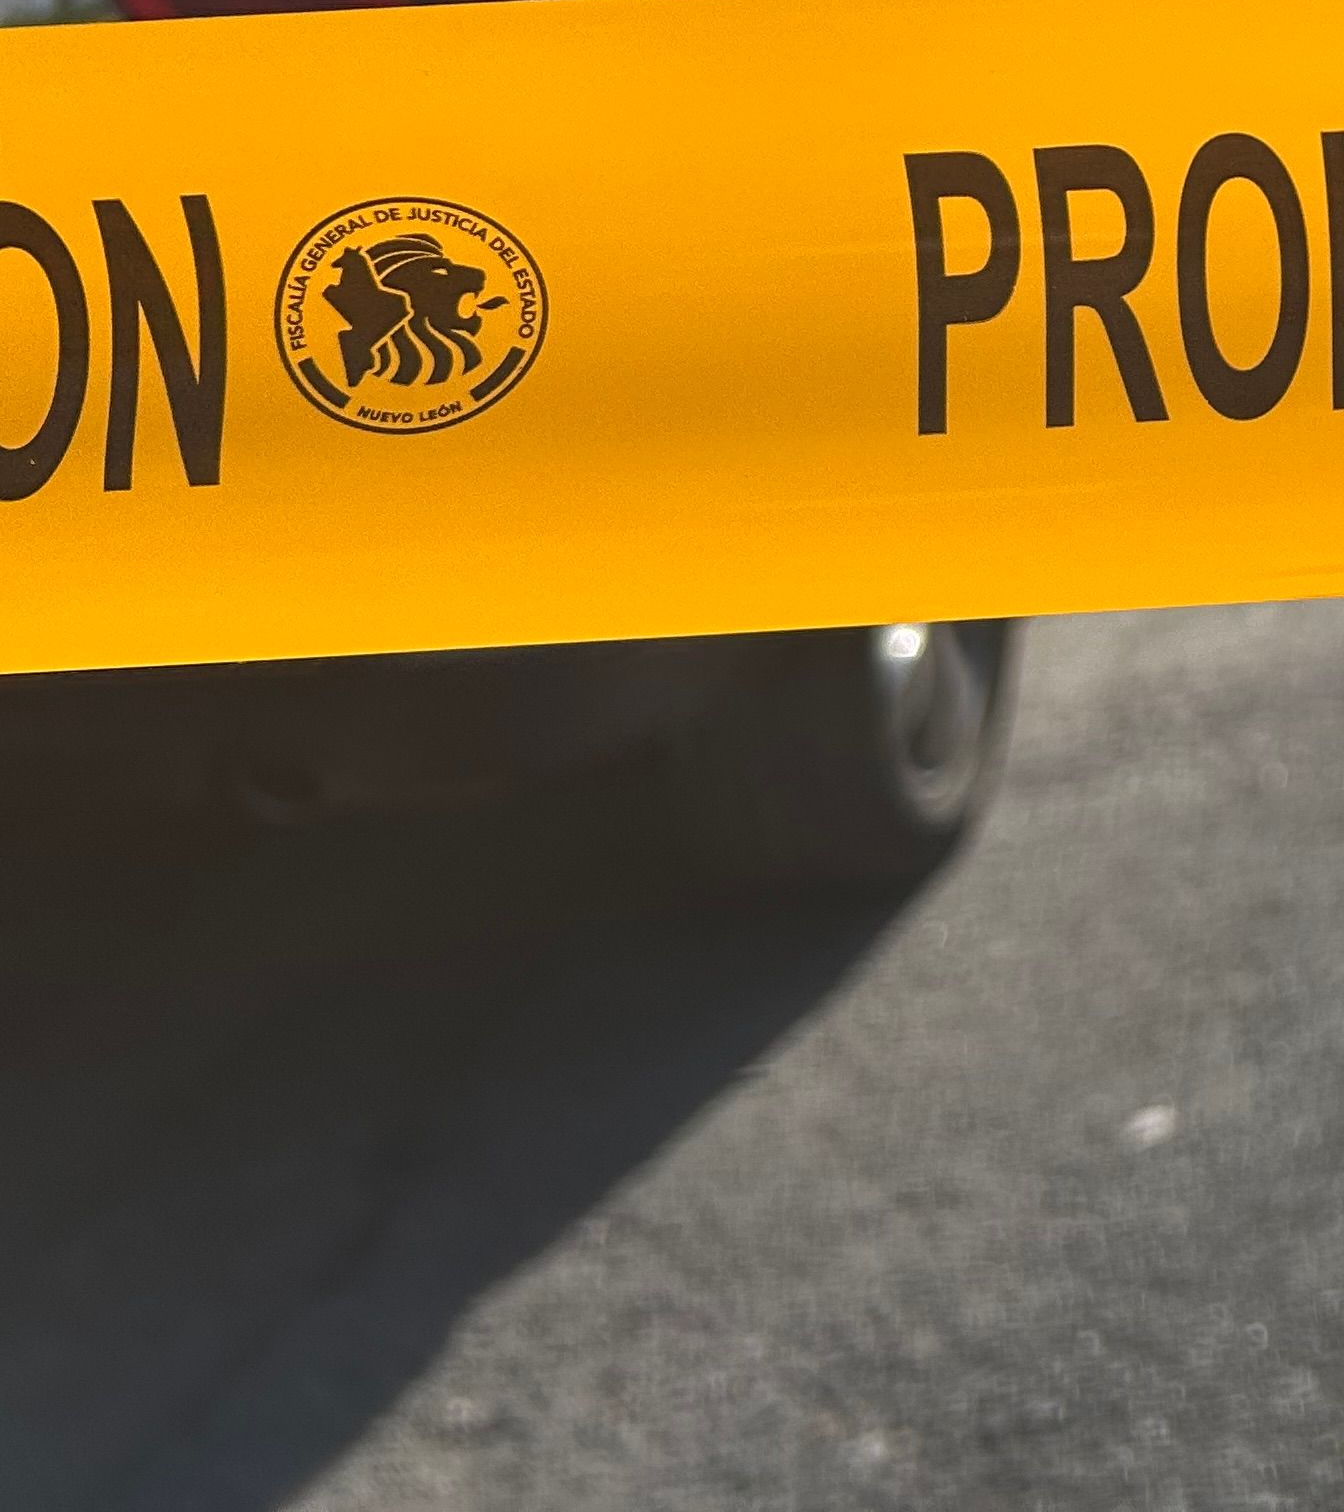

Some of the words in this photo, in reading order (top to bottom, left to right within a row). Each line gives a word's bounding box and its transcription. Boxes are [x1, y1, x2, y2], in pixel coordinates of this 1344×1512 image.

[287, 274, 311, 351] FISCALÍA
[300, 215, 373, 273] GENERAL
[373, 207, 402, 224] DE
[406, 207, 489, 243] JUSTICIA
[489, 236, 521, 270] DEL
[513, 267, 537, 339] ESTADO
[356, 404, 414, 424] NUEVO
[418, 400, 463, 423] LEÓN
